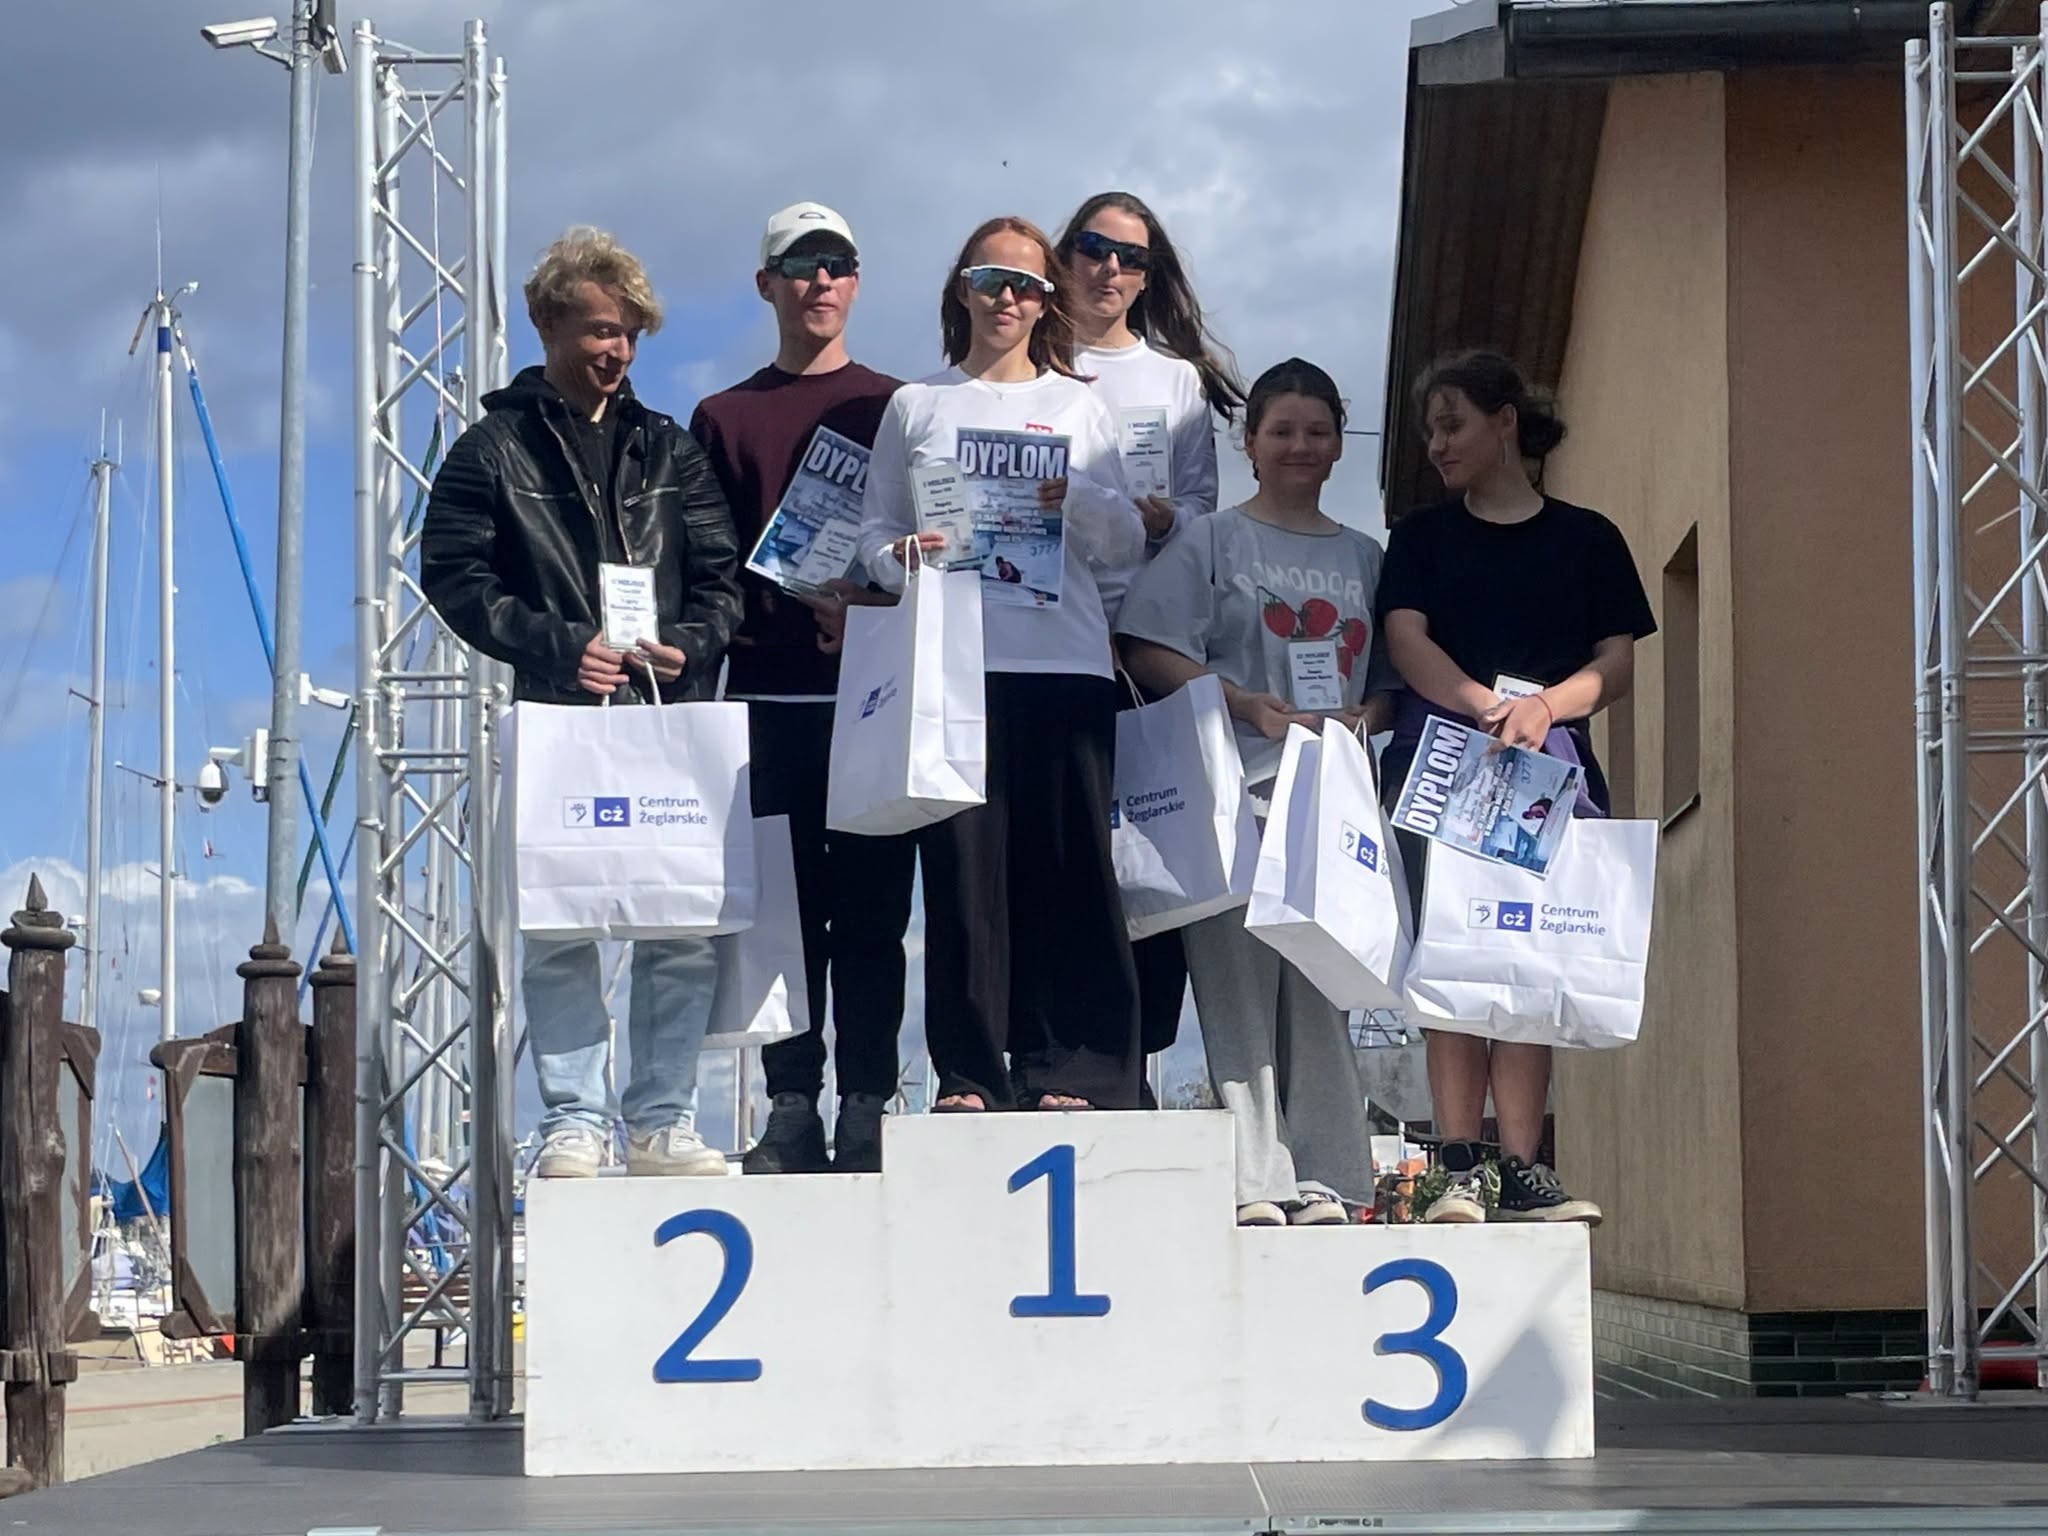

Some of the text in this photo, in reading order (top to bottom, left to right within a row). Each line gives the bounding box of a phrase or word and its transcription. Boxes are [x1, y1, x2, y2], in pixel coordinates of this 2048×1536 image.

[806, 440, 870, 494] DYPL
[960, 440, 1066, 479] DYPLOM
[1126, 787, 1178, 807] Centrum
[1405, 724, 1469, 833] DYPLOM
[639, 796, 699, 808] Centrum
[639, 811, 708, 826] Żeglarskie
[1540, 917, 1606, 936] Żeglarskie
[1541, 903, 1599, 919] Centrum
[1009, 1144, 1110, 1317] 1
[653, 1209, 762, 1382] 2
[1362, 1258, 1468, 1430] 3
